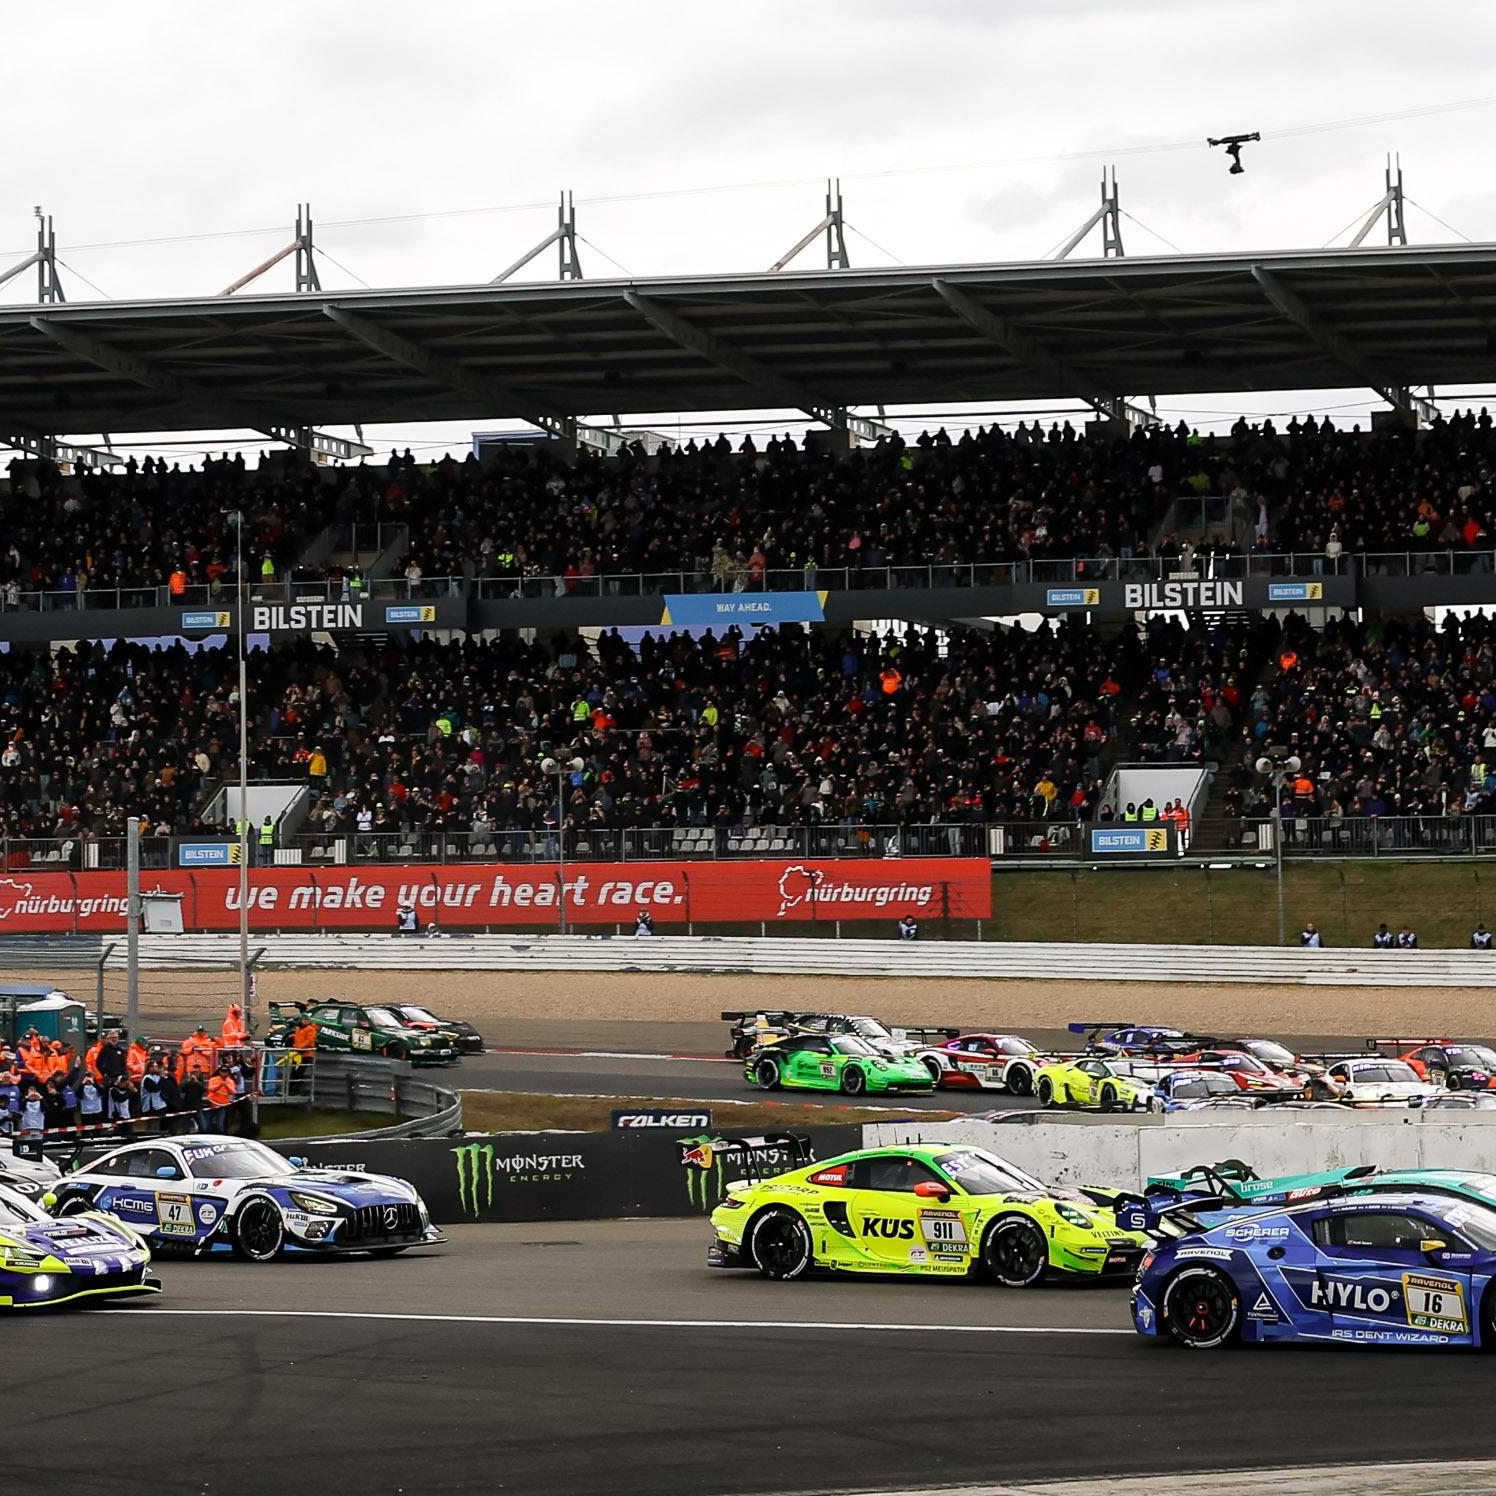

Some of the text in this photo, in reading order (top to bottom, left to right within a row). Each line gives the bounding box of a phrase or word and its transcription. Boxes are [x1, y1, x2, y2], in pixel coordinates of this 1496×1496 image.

[1125, 581, 1243, 609] BILSTEIN
[716, 602, 773, 613] WAY AHEAD.
[254, 604, 363, 630] BILSTEIN
[1098, 835, 1141, 846] BILSTEIN
[185, 849, 224, 859] BILSTEIN
[224, 875, 684, 910] we make your heart race.
[805, 880, 933, 906] nürburgring
[617, 1114, 709, 1128] FALKEN
[495, 1153, 586, 1171] MONSTER
[510, 1173, 573, 1182] ENERGY
[817, 1173, 843, 1182] MOTUL
[1240, 1181, 1274, 1193] brose
[112, 1196, 154, 1212] KCMG
[168, 1205, 182, 1221] 47
[862, 1216, 915, 1240] KÜS
[933, 1221, 953, 1239] 911
[1091, 1229, 1125, 1239] VELTINS
[1225, 1227, 1290, 1237] SCHERER
[942, 1242, 969, 1253] DEKRA
[1410, 1277, 1454, 1290] RAVENOL
[1424, 1292, 1443, 1314] 16
[1429, 1317, 1465, 1333] DEKRA
[1331, 1329, 1449, 1344] IRS DENT WIZARD
